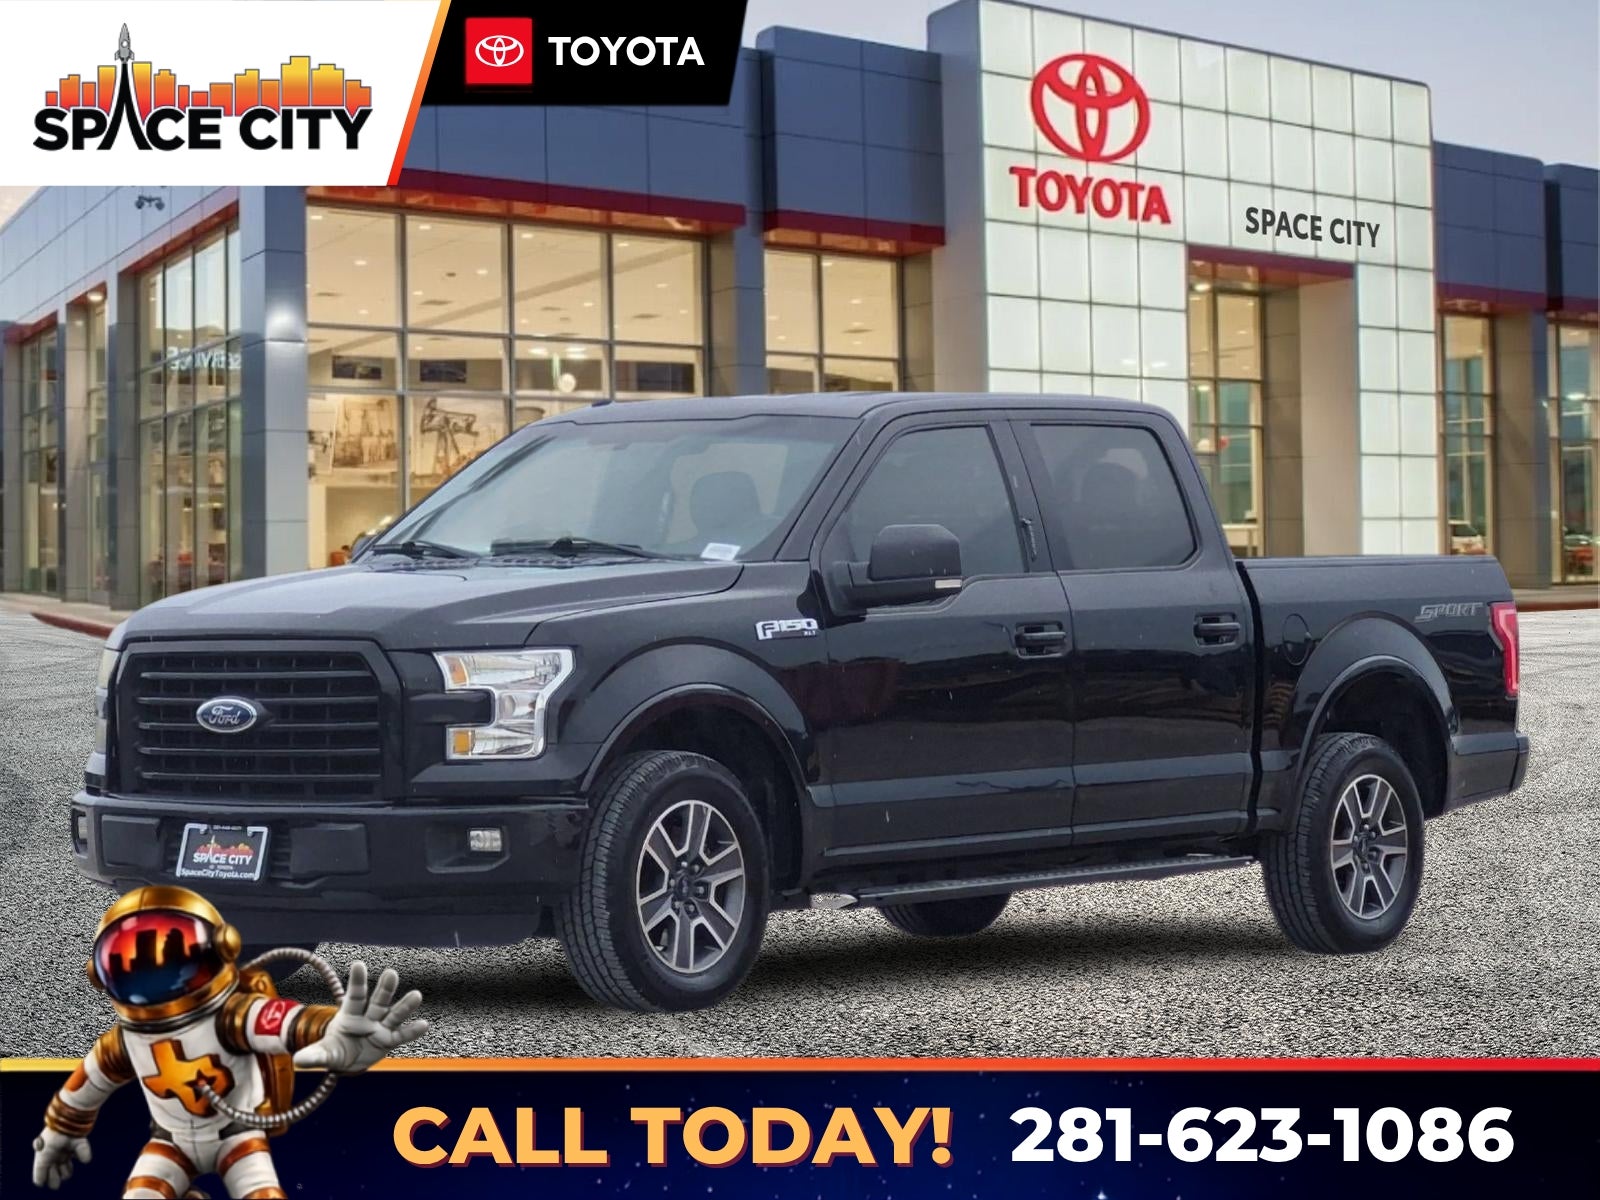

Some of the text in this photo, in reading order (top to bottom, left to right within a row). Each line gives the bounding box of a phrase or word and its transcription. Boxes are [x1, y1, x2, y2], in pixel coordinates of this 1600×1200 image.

[1009, 166, 1171, 225] TOYOTA
[1245, 206, 1380, 248] SPACE CITY
[1414, 602, 1483, 624] SPORT
[208, 705, 241, 725] Ford
[193, 850, 252, 866] SPACE CITY
